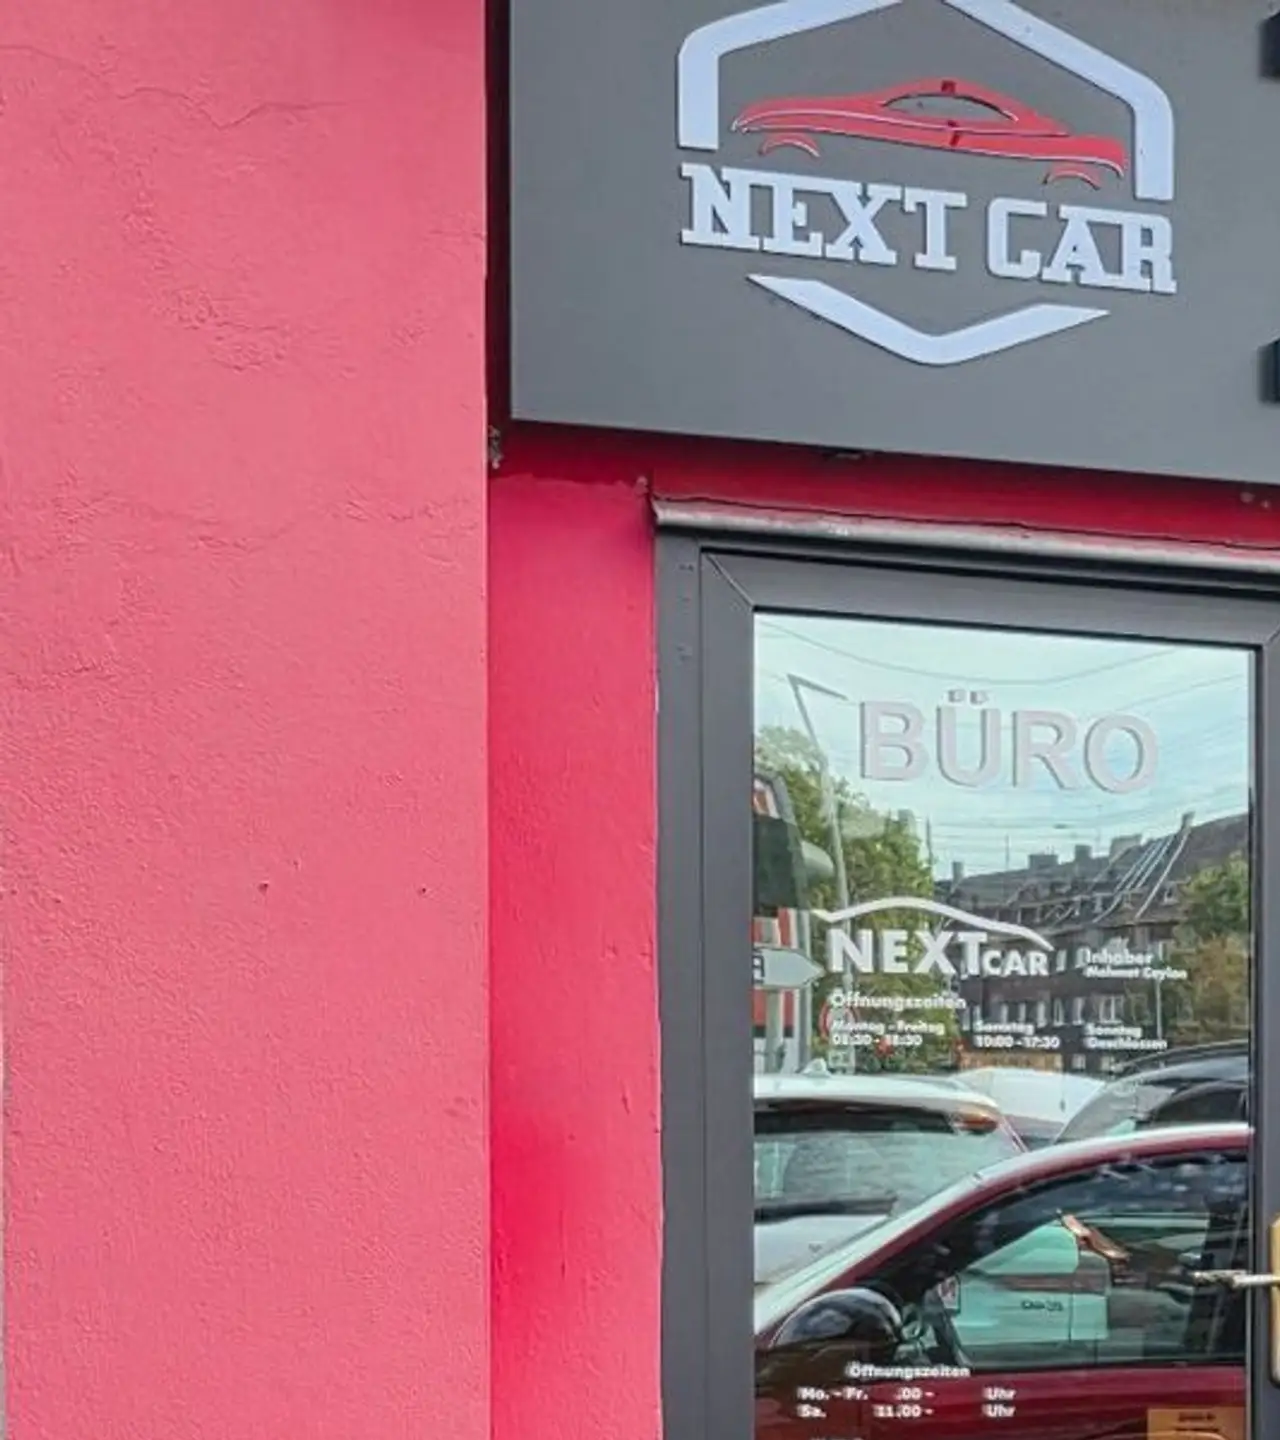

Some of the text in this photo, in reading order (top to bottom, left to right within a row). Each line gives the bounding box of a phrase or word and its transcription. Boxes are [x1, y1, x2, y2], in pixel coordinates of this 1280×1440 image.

[680, 163, 1177, 294] NEXT CAR
[860, 688, 1158, 794] BÜRO
[847, 1361, 970, 1379] Öffnungszeiten
[983, 1387, 1015, 1400] Uhr
[982, 1404, 1015, 1417] Uhr
